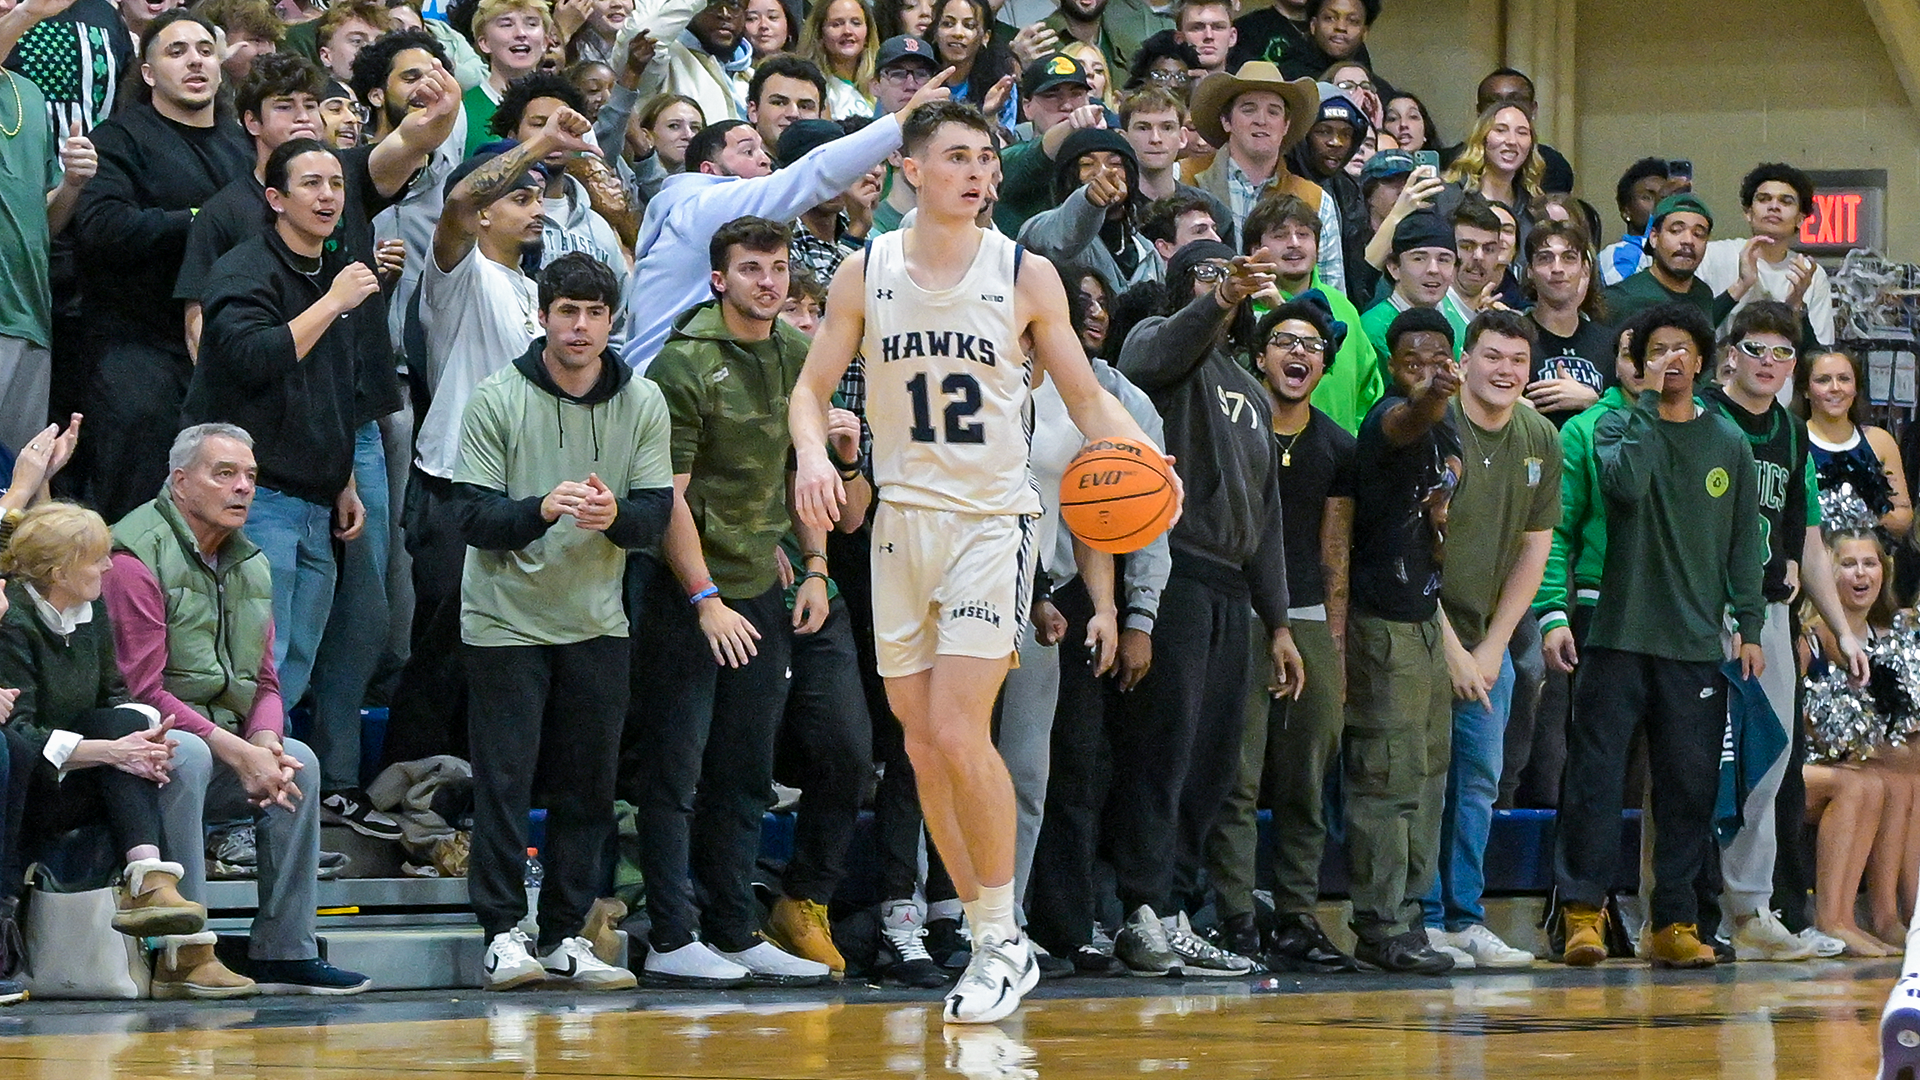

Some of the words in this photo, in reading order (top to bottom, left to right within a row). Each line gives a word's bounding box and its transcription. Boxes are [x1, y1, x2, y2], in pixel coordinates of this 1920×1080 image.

[882, 330, 996, 367] HAWKS
[906, 372, 986, 444] 12
[1078, 470, 1122, 490] EVO
